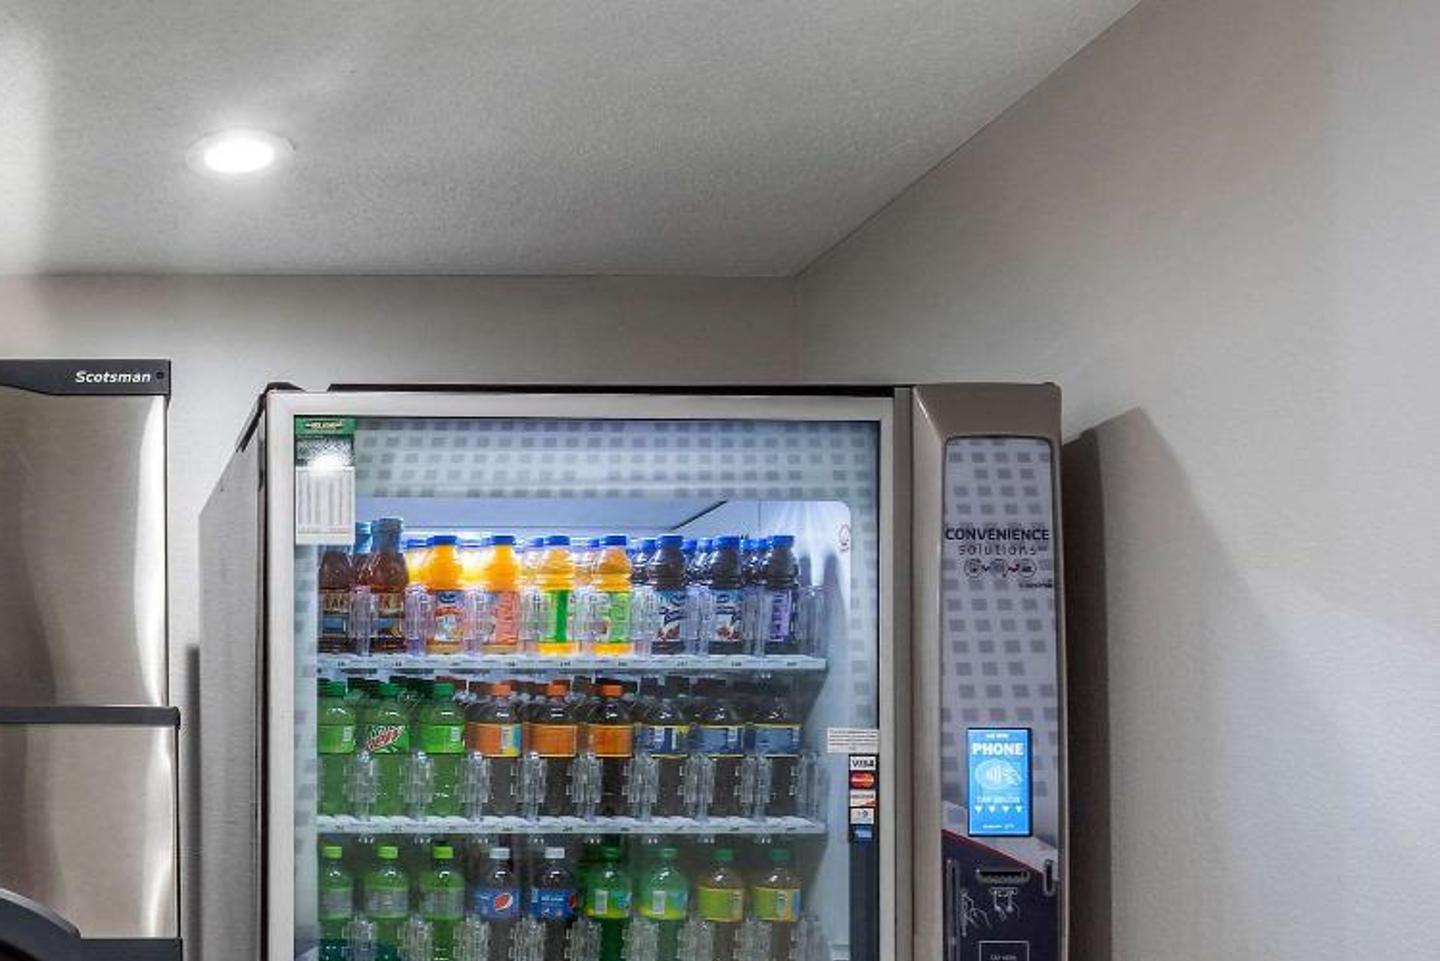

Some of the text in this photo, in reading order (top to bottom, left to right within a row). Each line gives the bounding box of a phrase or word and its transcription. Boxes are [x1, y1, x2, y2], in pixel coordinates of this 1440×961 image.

[75, 370, 152, 384] Scotsman
[945, 528, 1050, 541] CONVENIENCE
[971, 742, 1025, 756] PHONE
